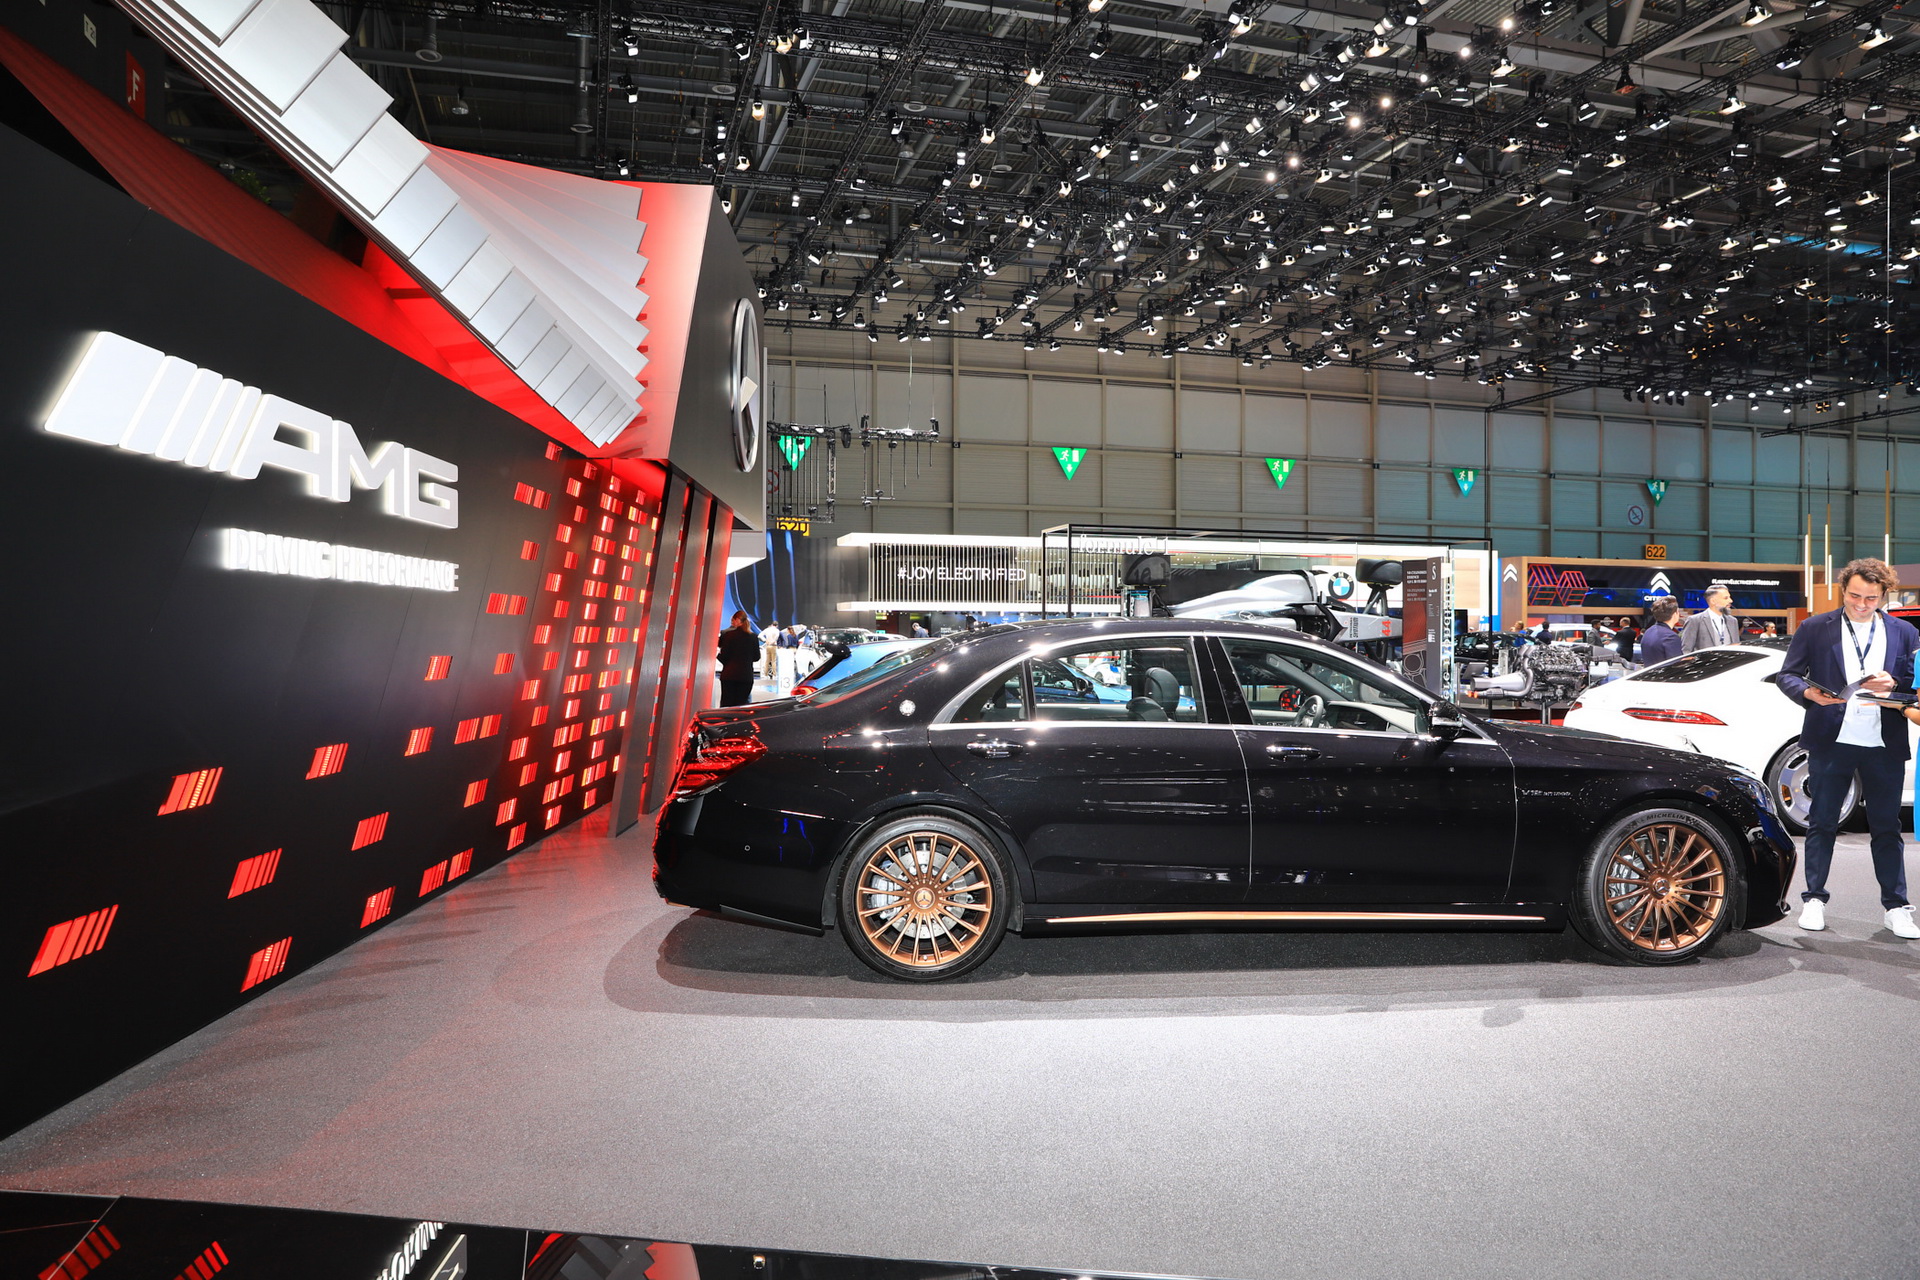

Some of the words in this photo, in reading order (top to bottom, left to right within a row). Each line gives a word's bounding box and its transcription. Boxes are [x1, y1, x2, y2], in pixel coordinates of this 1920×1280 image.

[1078, 534, 1154, 555] formule
[1163, 536, 1170, 556] 1
[1646, 545, 1665, 558] 622
[227, 527, 332, 578] DRIVING
[334, 545, 459, 591] PERFORMANCE
[897, 566, 935, 580] #JOY
[937, 567, 1027, 581] ELECTRIFIED
[1381, 619, 1393, 637] 44
[780, 677, 791, 689] i3
[1646, 812, 1686, 821] MICHELIN
